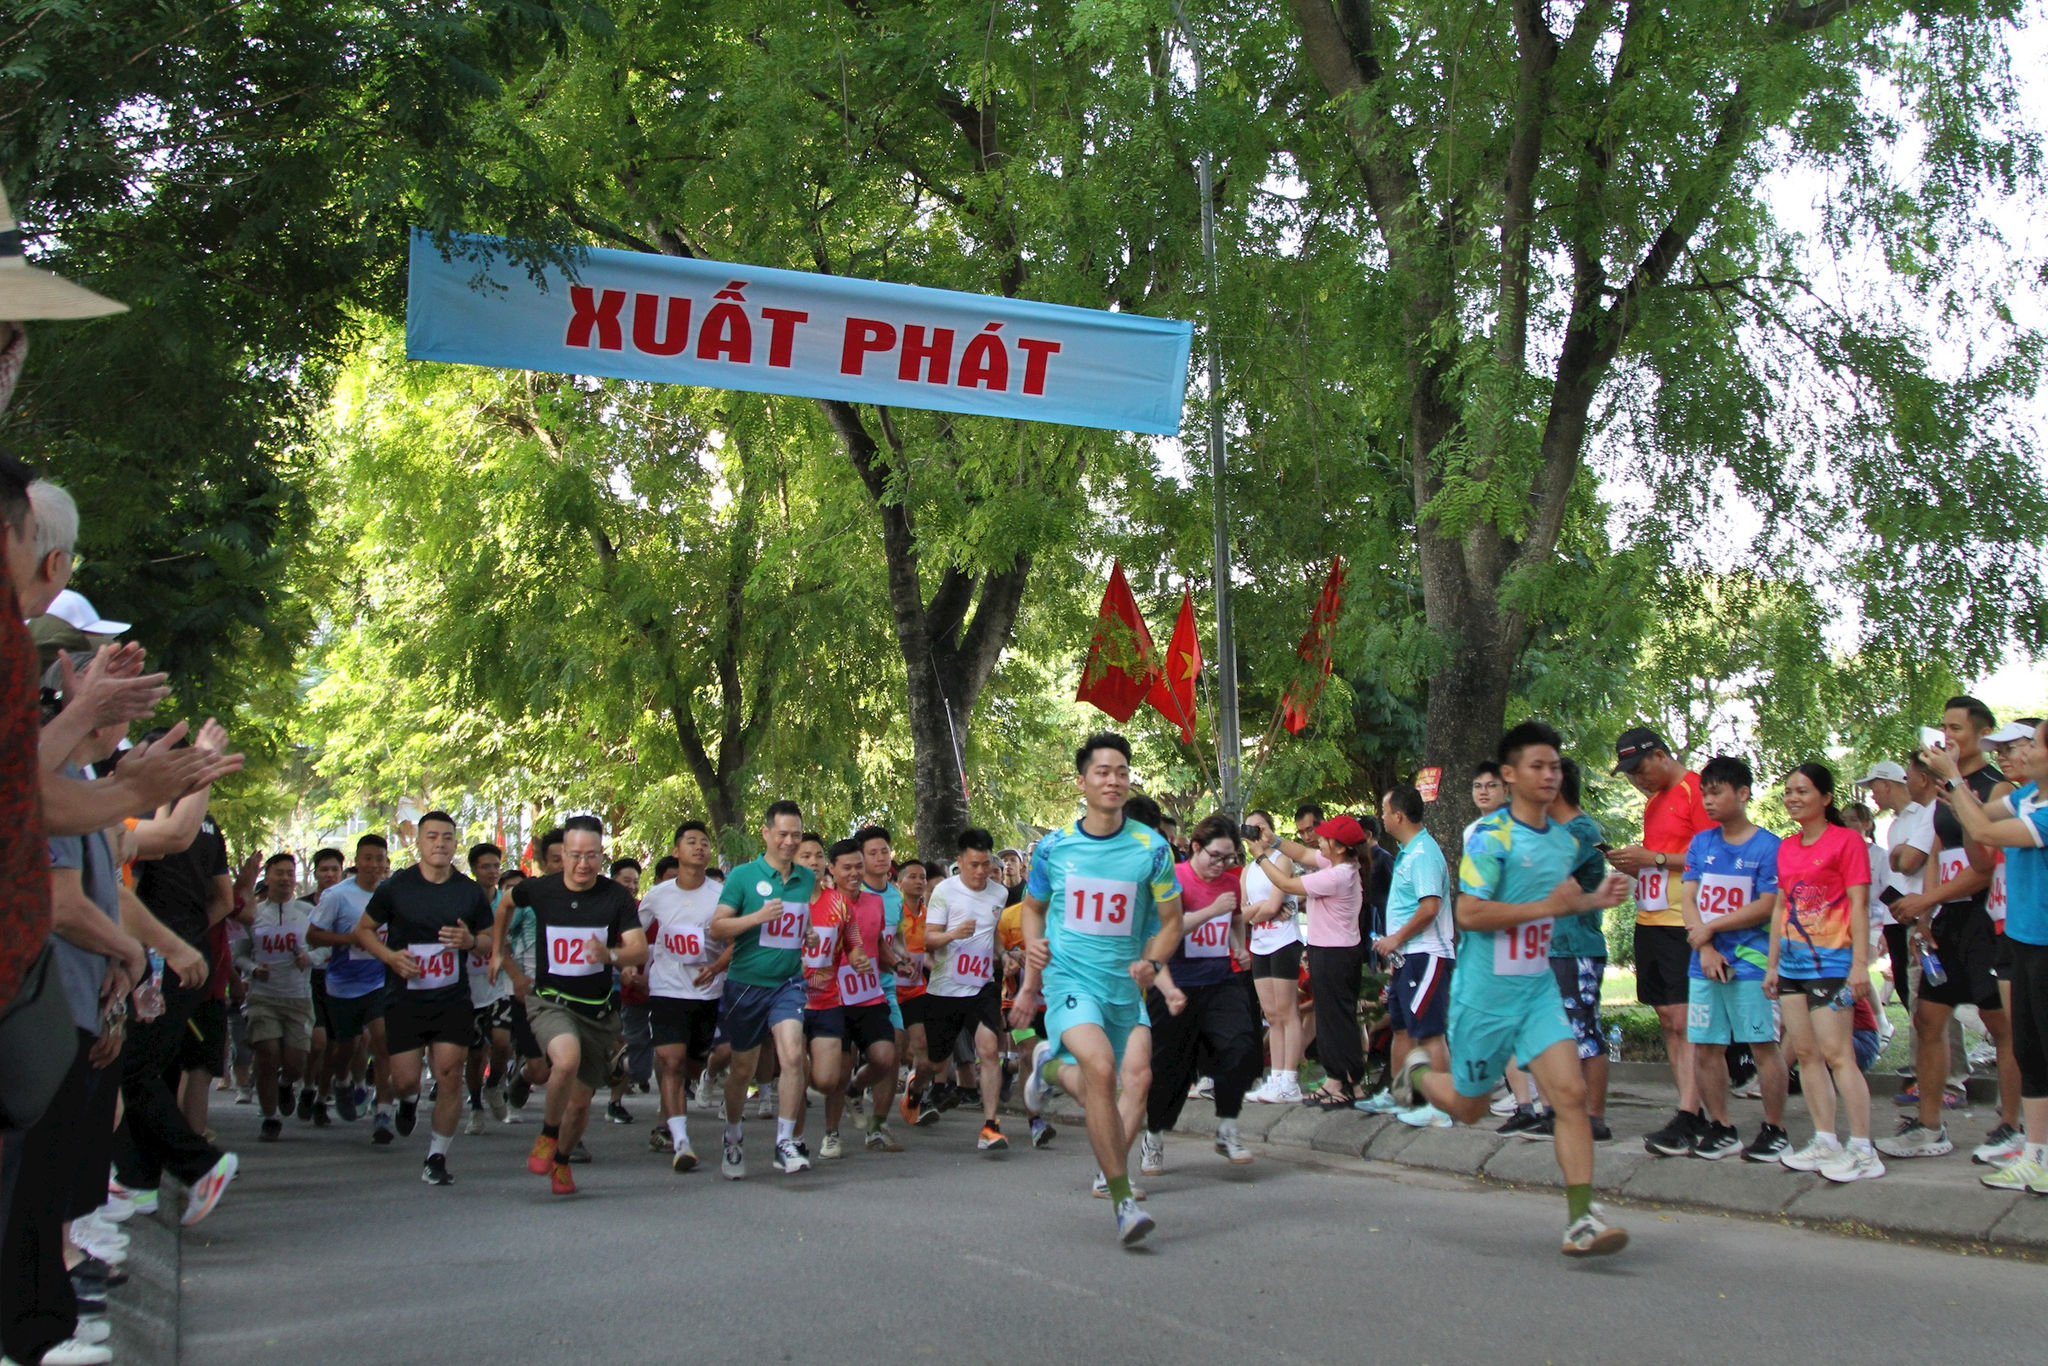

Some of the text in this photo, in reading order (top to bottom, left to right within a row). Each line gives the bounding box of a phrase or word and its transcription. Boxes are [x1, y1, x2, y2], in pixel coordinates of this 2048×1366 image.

[566, 281, 1061, 396] XUẤT PHÁT
[1073, 889, 1127, 923] 113
[1699, 884, 1744, 914] 529
[767, 912, 804, 938] 021
[1190, 922, 1229, 947] 407
[263, 932, 297, 954] 446
[664, 933, 700, 955] 406
[1505, 923, 1552, 960] 195
[415, 951, 454, 979] 449
[957, 953, 990, 978] 042
[1065, 994, 1077, 1009] 6
[1465, 1060, 1489, 1083] 12
